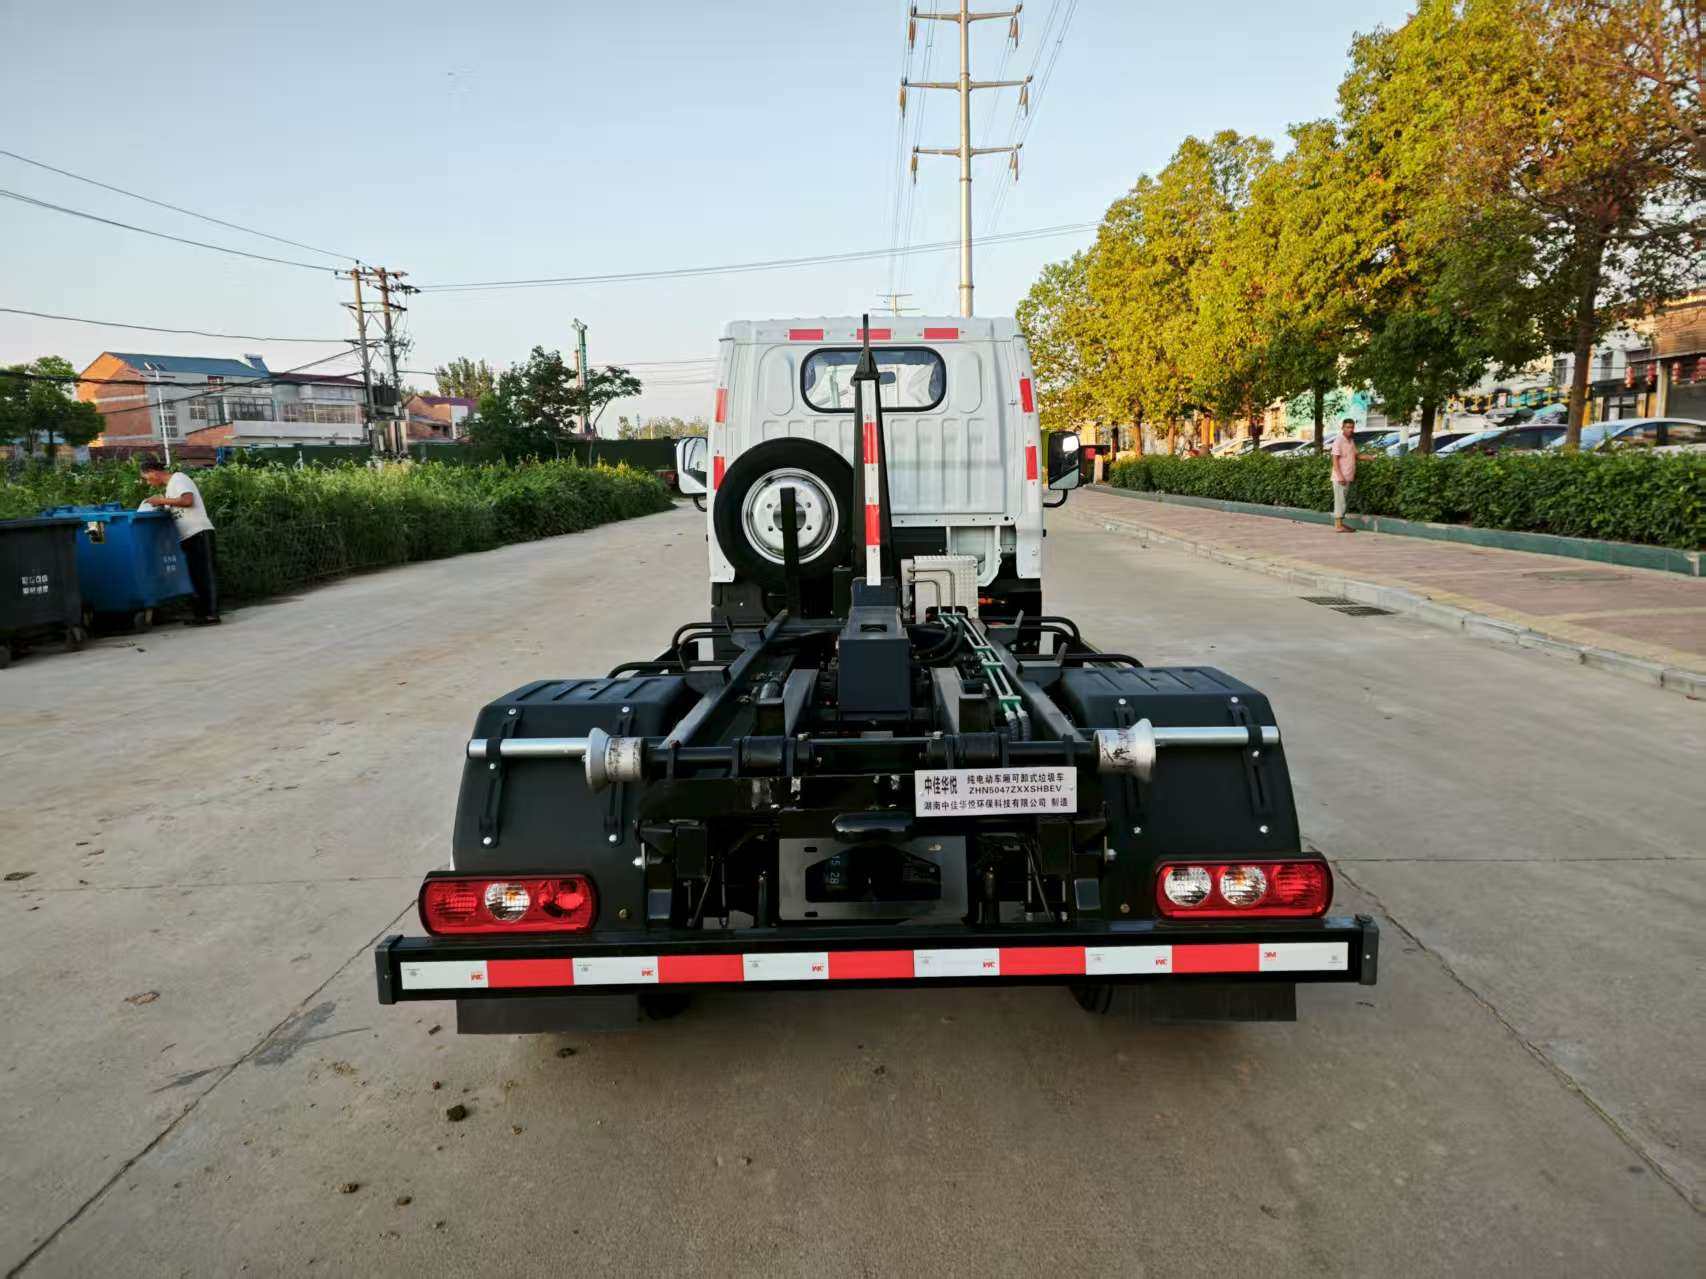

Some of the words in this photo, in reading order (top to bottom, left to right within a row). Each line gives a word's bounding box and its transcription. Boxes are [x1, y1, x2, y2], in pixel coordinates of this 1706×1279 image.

[967, 773, 1064, 784] 纯电动车厢可卸式垃圾车
[924, 776, 957, 794] 中佳华悦
[969, 785, 1062, 794] ZHN5047ZXXSHBEV
[924, 798, 1046, 810] 湖南中佳华悦环保科技有限公司
[1051, 797, 1068, 807] 制造
